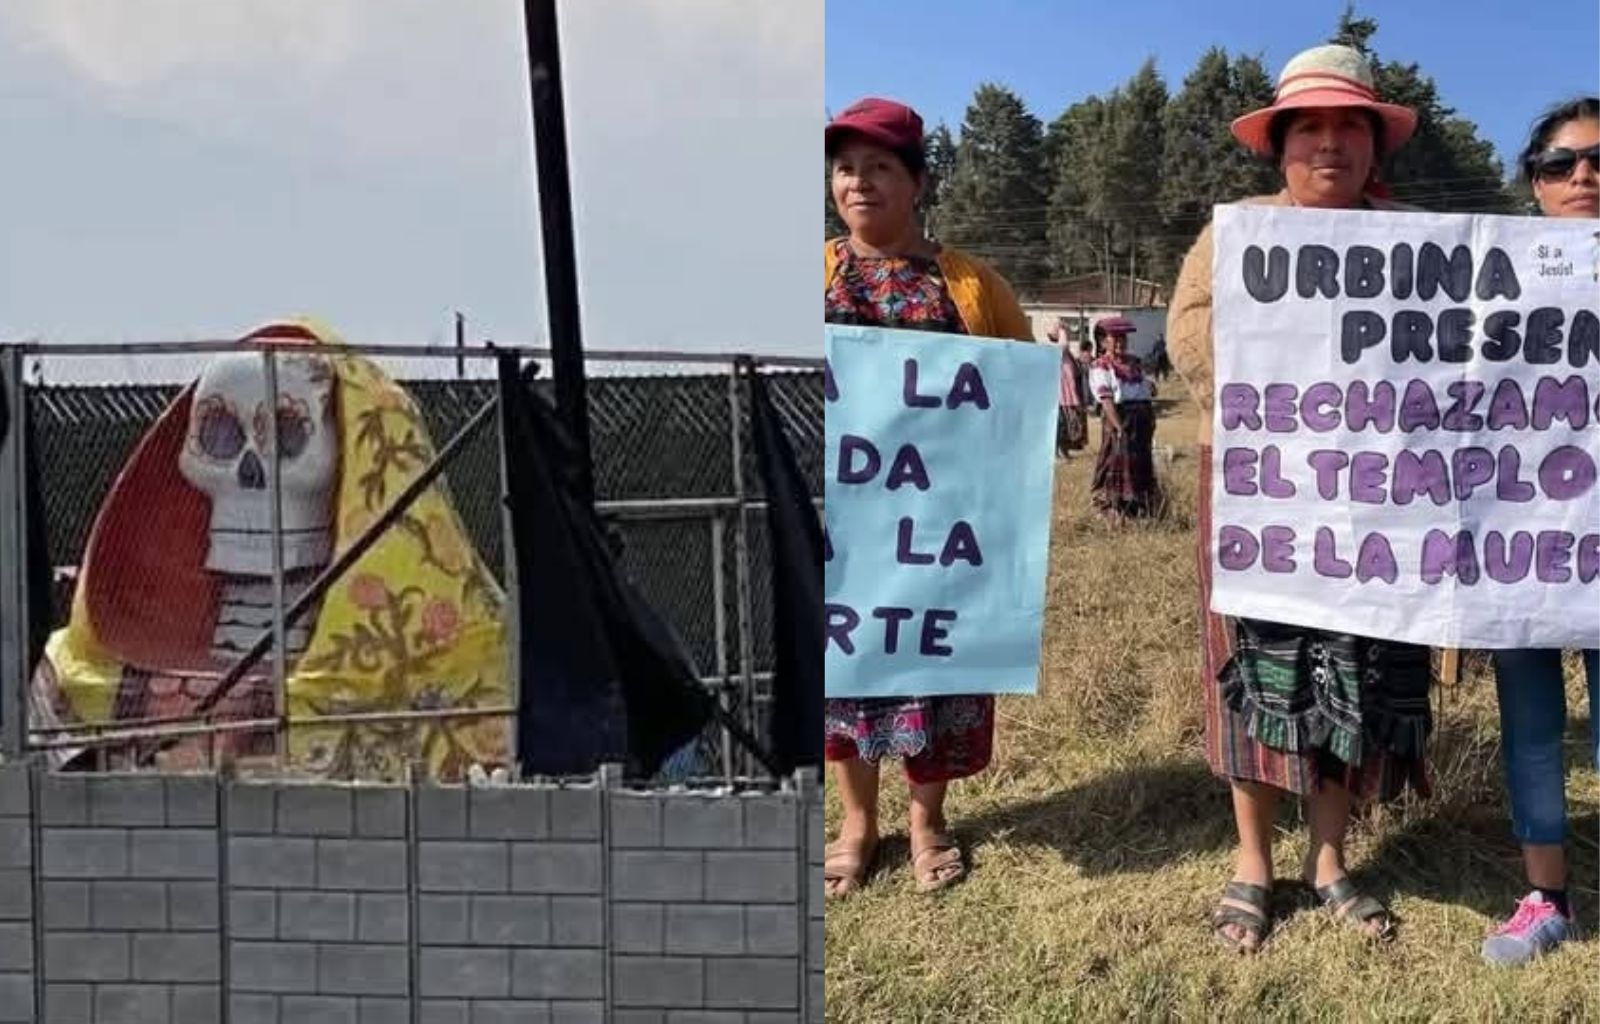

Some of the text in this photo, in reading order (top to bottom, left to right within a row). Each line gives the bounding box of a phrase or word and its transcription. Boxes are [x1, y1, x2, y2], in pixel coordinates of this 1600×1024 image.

[1242, 242, 1521, 303] URBINA
[1554, 248, 1562, 258] a
[903, 358, 990, 410] LA
[1221, 375, 1600, 434] RECHAZAM
[837, 434, 931, 491] DA
[1224, 444, 1597, 506] EL TEMPLO
[896, 516, 983, 567] LA
[1219, 525, 1297, 573] DE
[1313, 526, 1398, 585] LA
